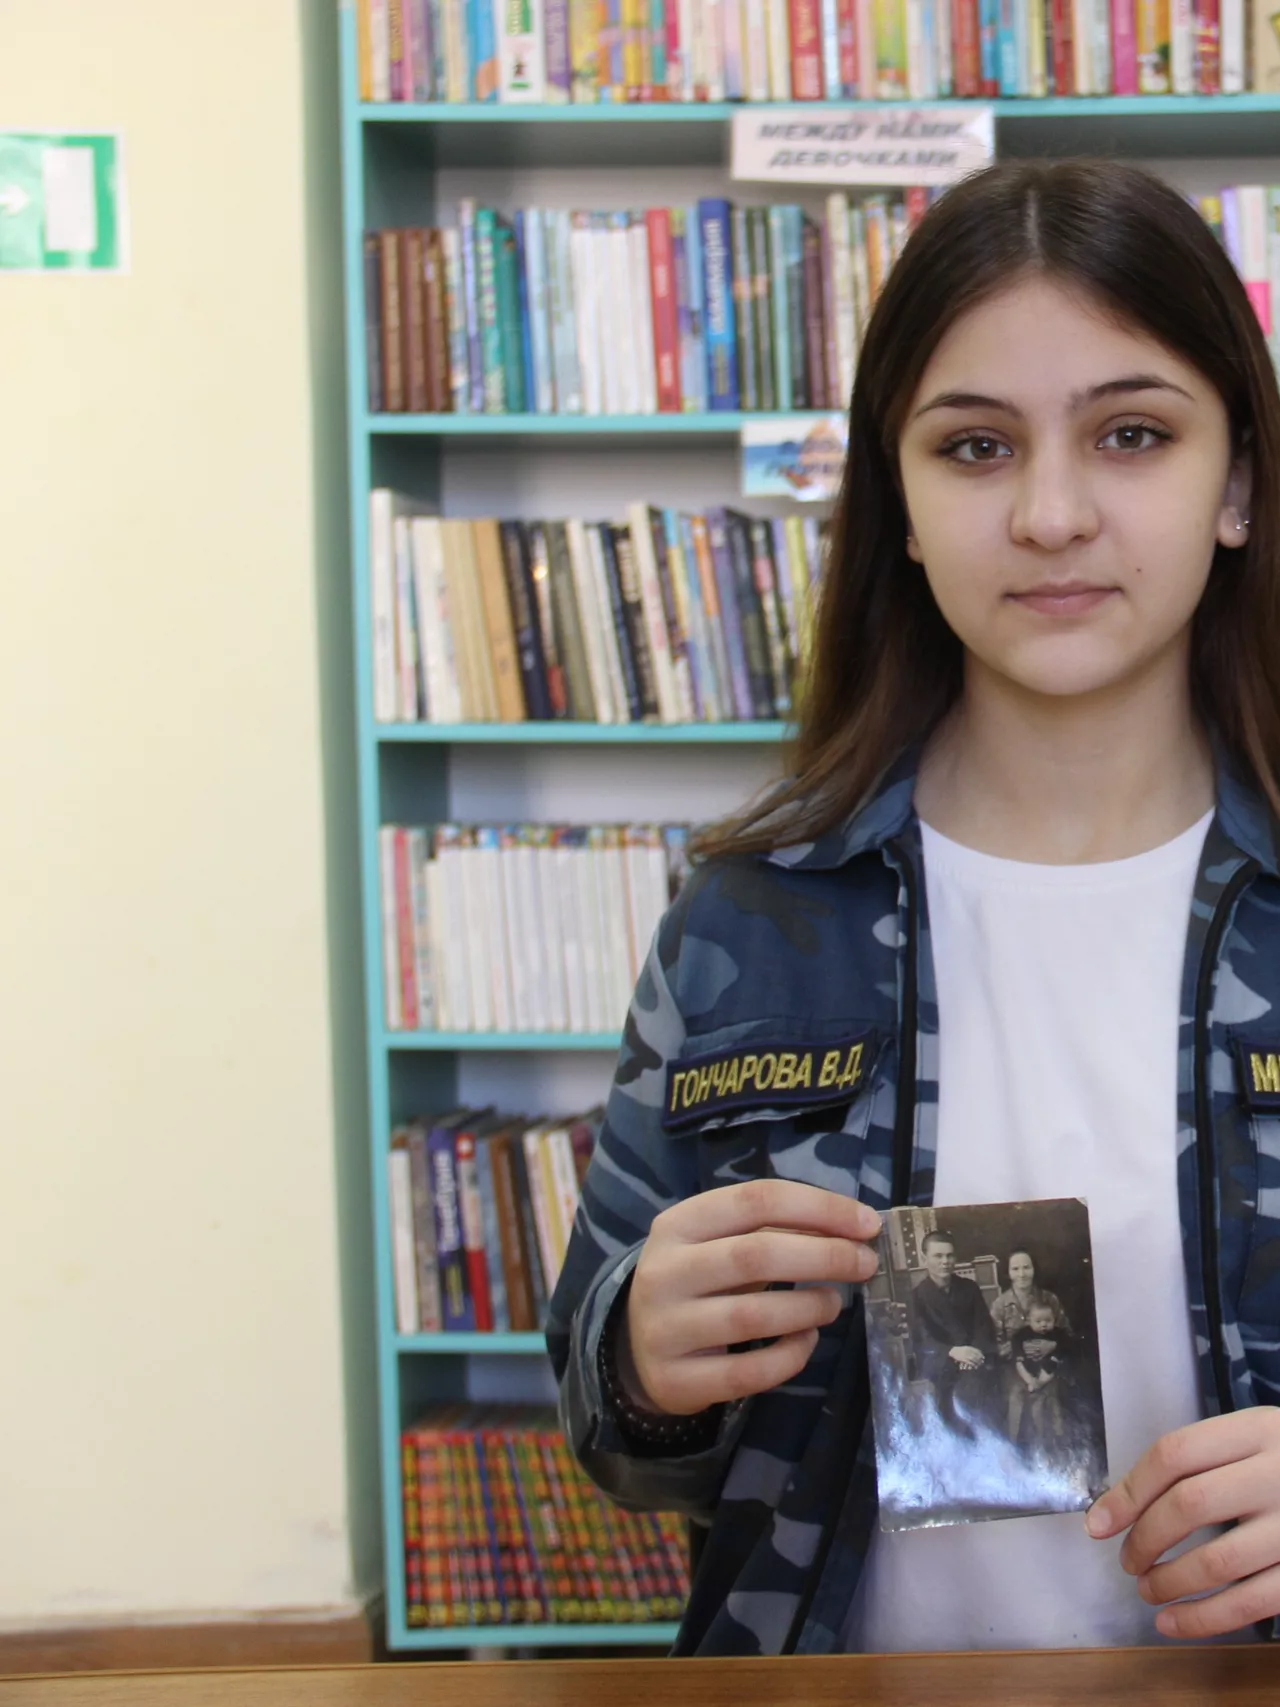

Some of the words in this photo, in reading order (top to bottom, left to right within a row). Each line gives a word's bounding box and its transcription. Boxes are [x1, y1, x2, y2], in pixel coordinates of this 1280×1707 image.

[758, 121, 867, 142] МЕЖДУ
[767, 148, 959, 169] ДЕВОЧКАМИ
[669, 1052, 813, 1113] ГОНЧАРОВА
